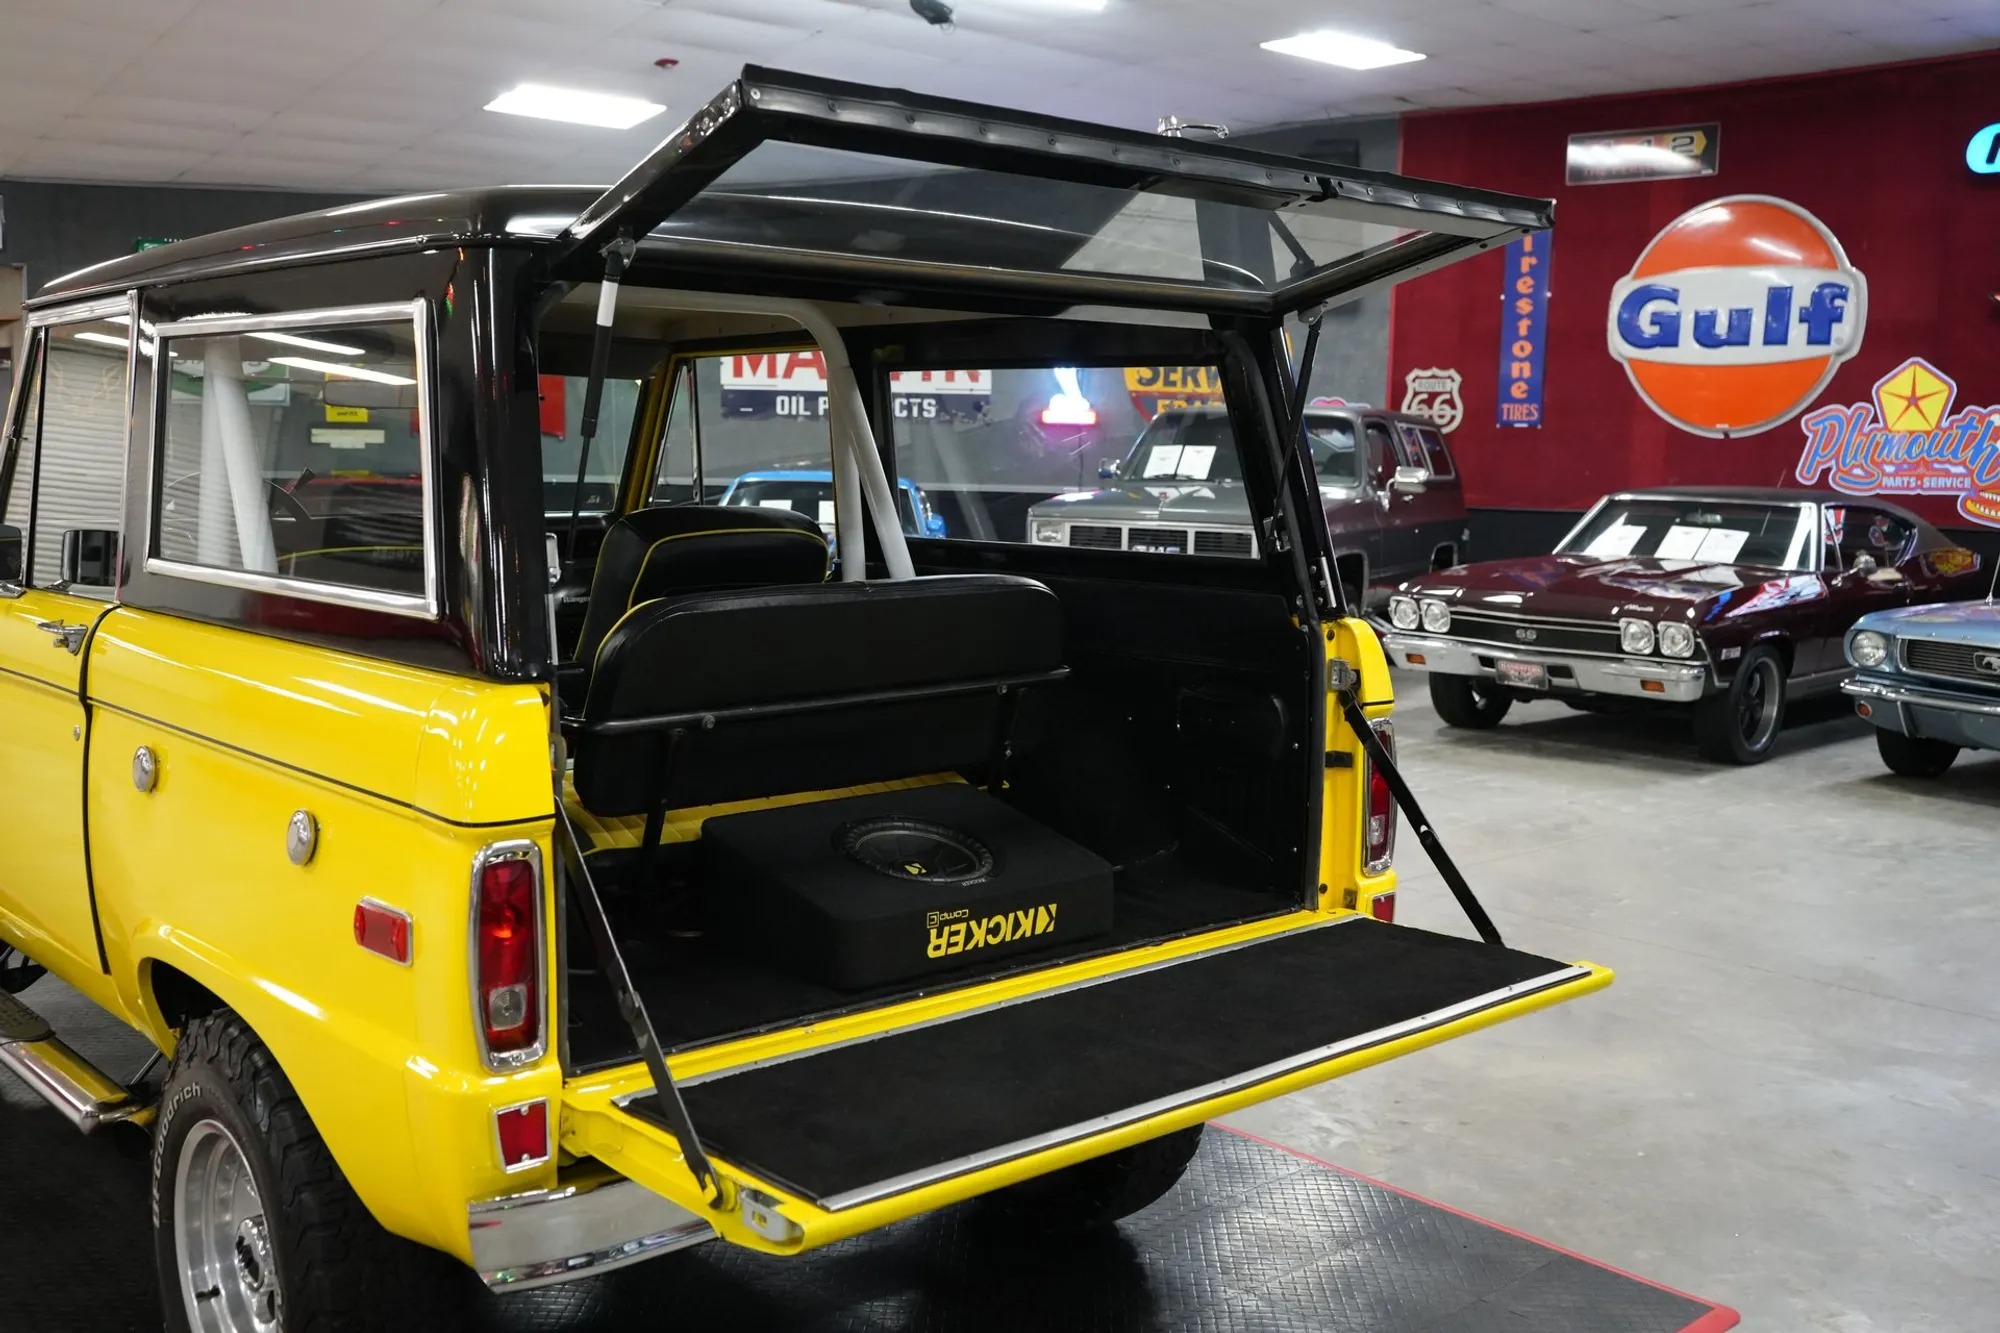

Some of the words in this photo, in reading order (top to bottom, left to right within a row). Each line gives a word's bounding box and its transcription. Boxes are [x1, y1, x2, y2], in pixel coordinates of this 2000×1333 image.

[1509, 235, 1538, 399] irestone
[1617, 282, 1850, 349] Gulf
[776, 396, 811, 416] OIL
[1410, 393, 1452, 425] 66
[1501, 402, 1540, 421] TIRES
[1805, 411, 2000, 486] Plymouth
[1882, 476, 1917, 488] PARTS
[1923, 477, 1972, 489] SERVICE
[927, 907, 1035, 958] KICKER
